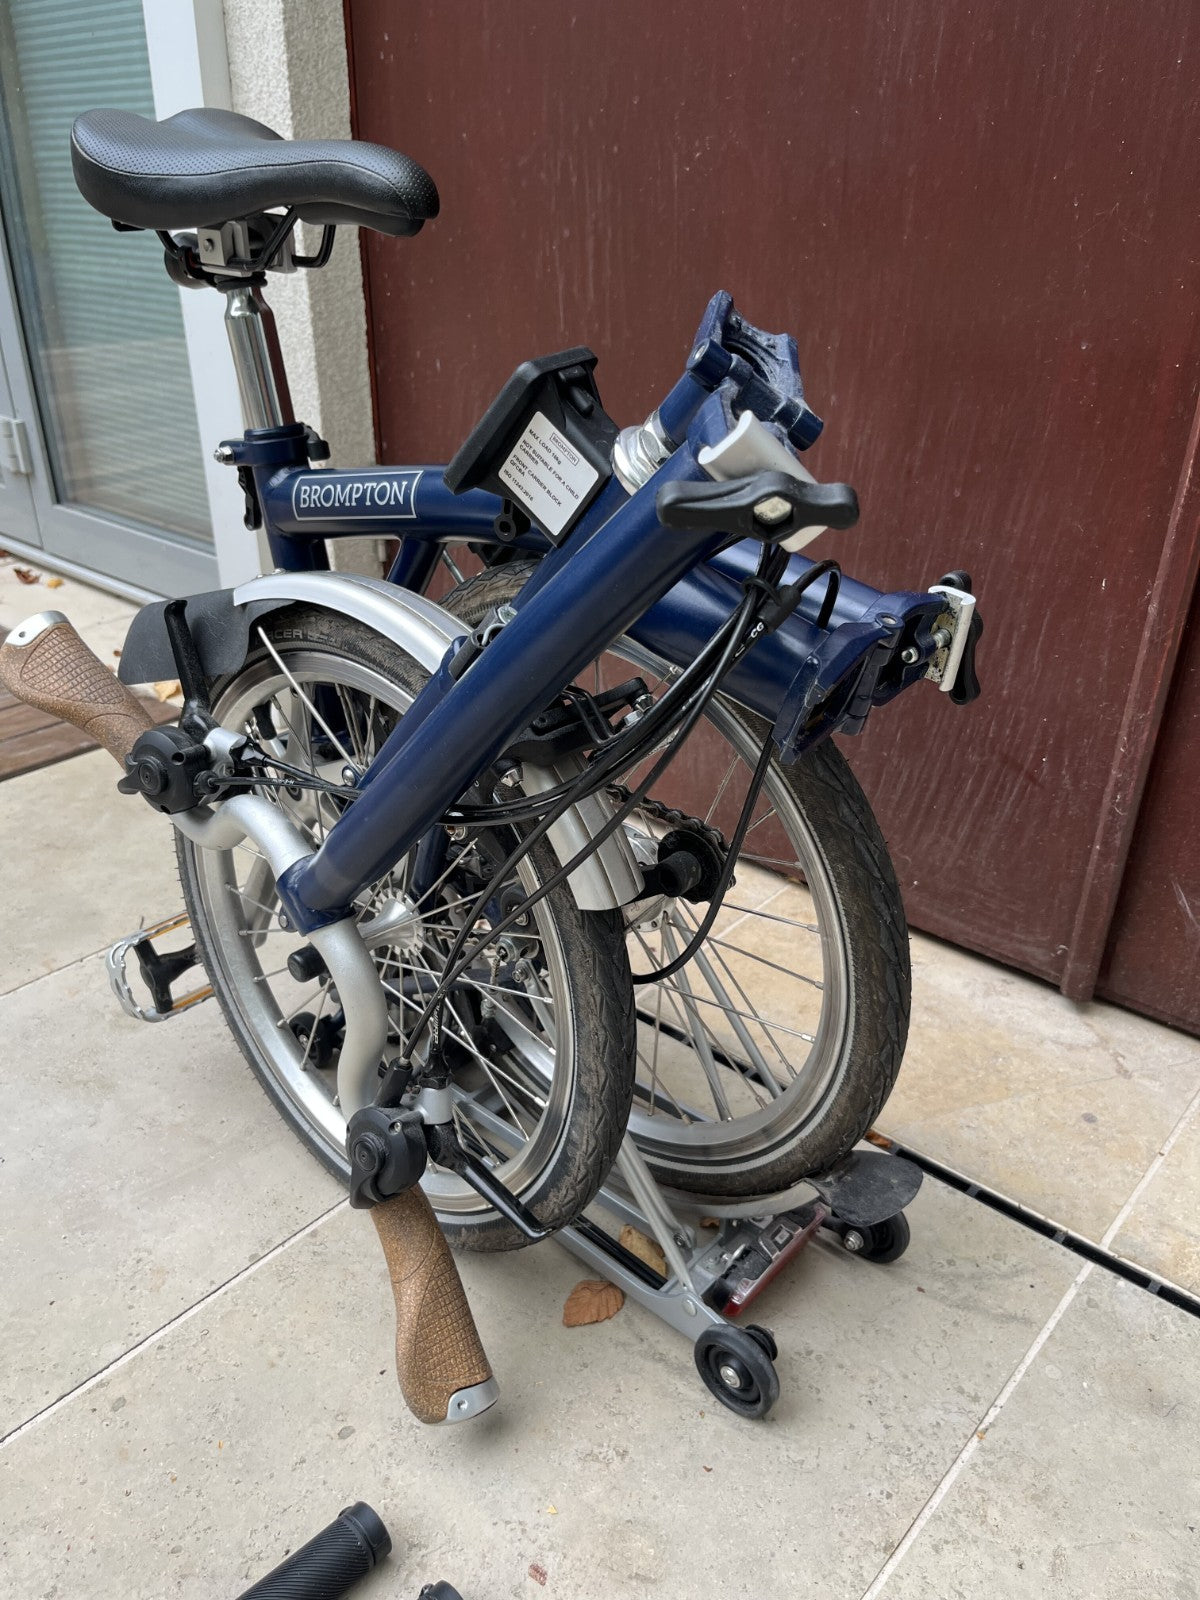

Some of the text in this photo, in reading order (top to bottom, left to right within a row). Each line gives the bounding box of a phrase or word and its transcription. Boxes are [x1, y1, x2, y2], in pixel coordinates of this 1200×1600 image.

[519, 444, 539, 466] CARRIER
[529, 429, 539, 439] MAX
[539, 440, 552, 454] LOAD
[552, 436, 577, 463] BROMPTON
[503, 469, 512, 479] ISO
[513, 454, 563, 507] FRONT CARRIER BLOCK
[522, 440, 532, 450] NOT
[532, 449, 553, 472] SUITABLE
[552, 470, 563, 482] FOR
[565, 484, 580, 500] CHILD
[300, 481, 408, 508] BROMPTON
